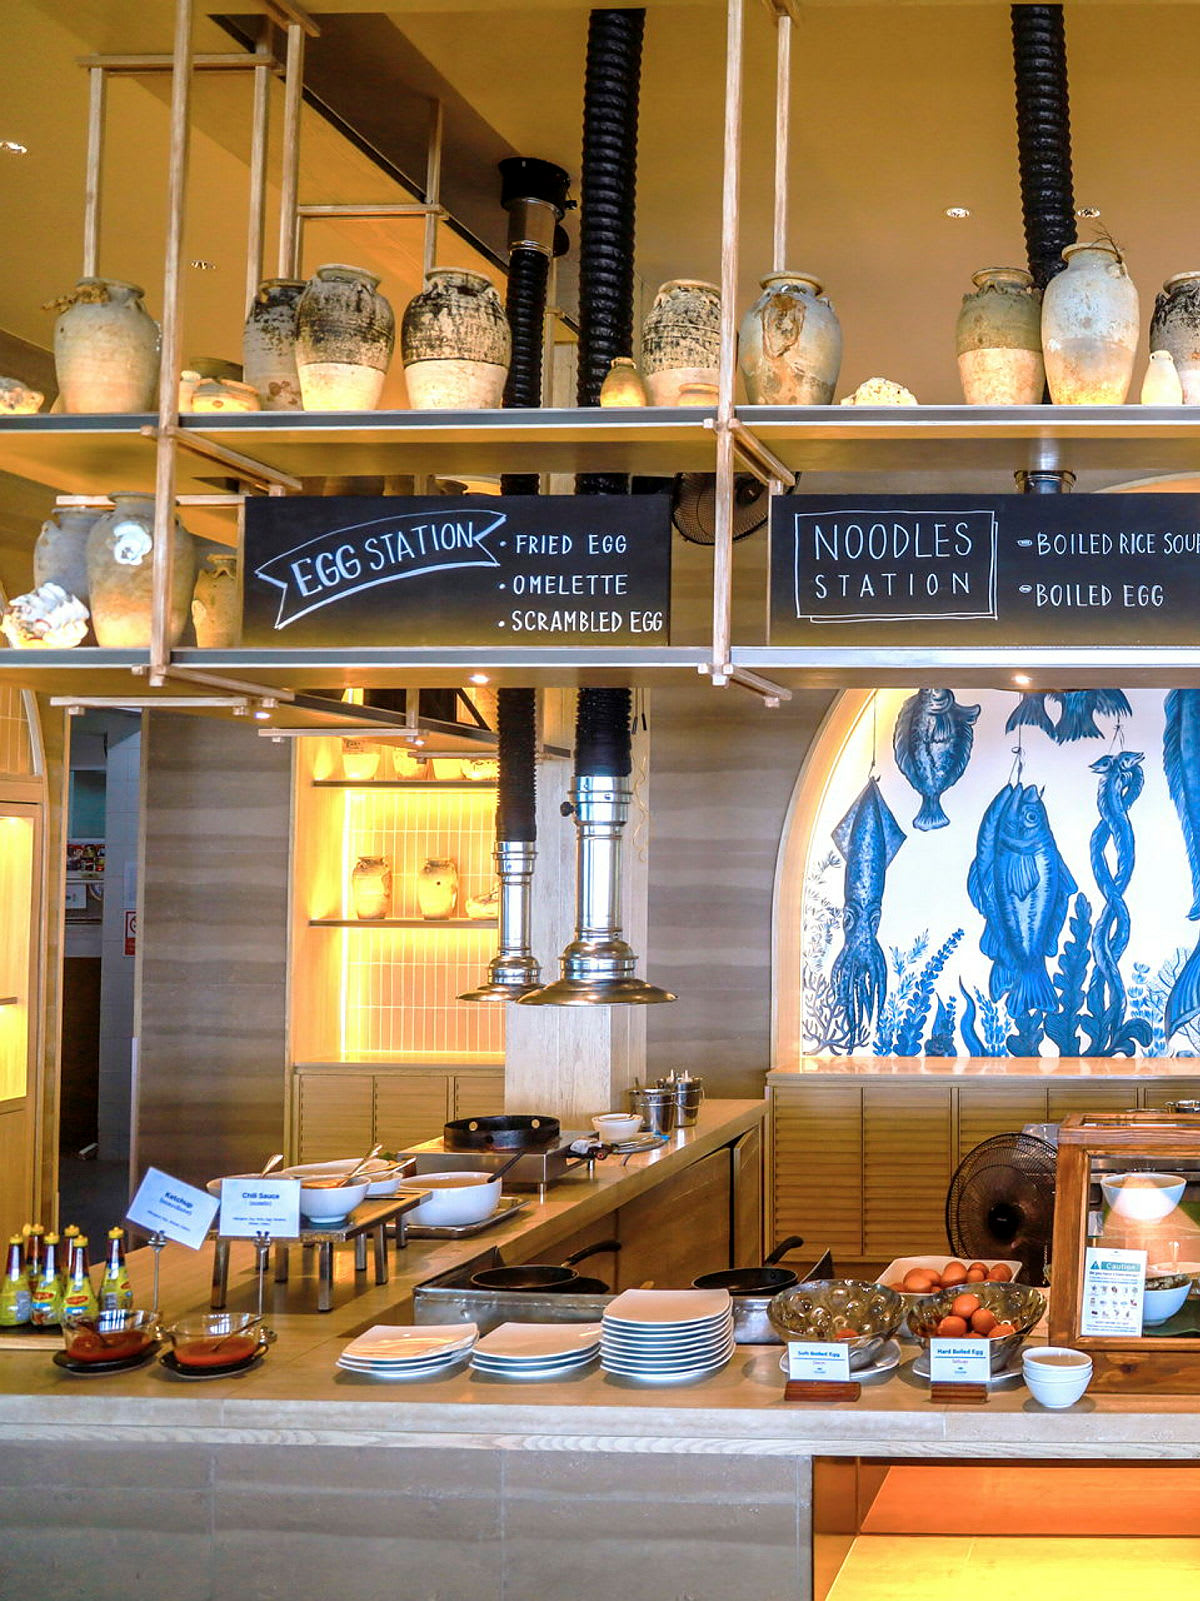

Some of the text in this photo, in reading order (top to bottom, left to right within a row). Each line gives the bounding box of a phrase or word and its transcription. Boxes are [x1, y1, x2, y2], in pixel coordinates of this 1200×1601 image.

[515, 534, 627, 555] FRIED EGG
[813, 521, 973, 561] NOODLES
[1036, 532, 1113, 556] BOILED
[1119, 533, 1156, 555] RICE
[290, 521, 475, 597] EGG STATION
[513, 574, 628, 596] OMELETTE
[815, 571, 970, 599] STATION
[1035, 584, 1164, 608] BOILED EGG
[511, 611, 663, 633] SCRAMBLED EGG
[164, 1191, 194, 1209] Ketchup
[242, 1192, 280, 1200] Chili Sauce
[972, 1348, 984, 1356] Egg
